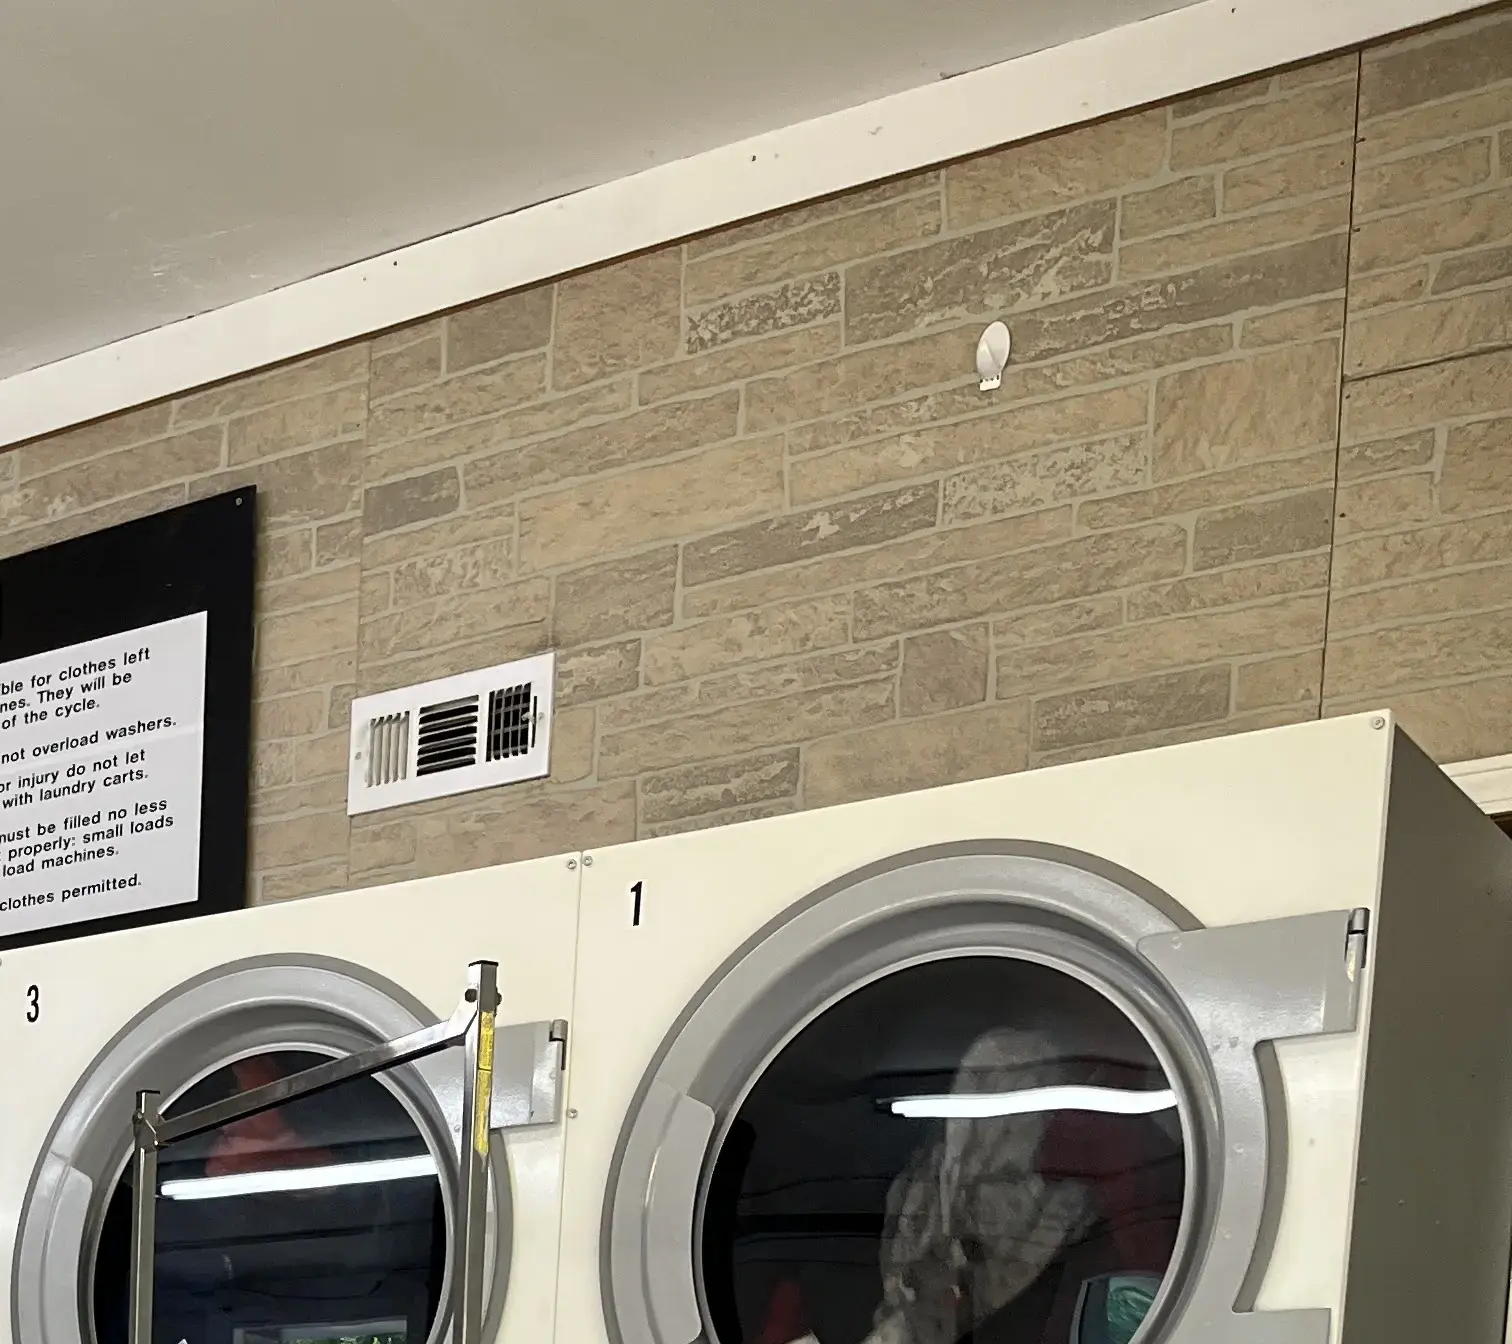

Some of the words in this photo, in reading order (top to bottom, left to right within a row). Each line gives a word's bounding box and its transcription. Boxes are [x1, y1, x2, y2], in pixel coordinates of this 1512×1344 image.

[30, 674, 52, 688] for
[58, 658, 117, 681] clothes
[123, 647, 150, 665] left
[37, 686, 74, 703] They
[80, 675, 106, 693] will
[111, 672, 133, 686] be
[0, 714, 17, 729] of
[23, 710, 48, 724] the
[54, 697, 100, 718] cycle.
[1, 747, 25, 764] not
[32, 730, 98, 757] overload
[105, 716, 178, 740] washers.
[17, 770, 60, 788] injury
[66, 763, 86, 777] do
[92, 754, 118, 772] not
[125, 749, 145, 764] let
[2, 791, 33, 809] with
[39, 779, 96, 801] laundry
[103, 768, 149, 787] carts.
[37, 823, 56, 835] be
[63, 810, 100, 830] filled
[108, 809, 127, 821] no
[134, 799, 167, 815] less
[82, 823, 124, 843] small
[129, 814, 174, 834] loads
[2, 858, 35, 877] load
[40, 846, 119, 869] machines.
[0, 892, 54, 911] clothes
[61, 873, 142, 902] permitted.
[630, 880, 643, 927] 1
[26, 984, 40, 1023] 3
